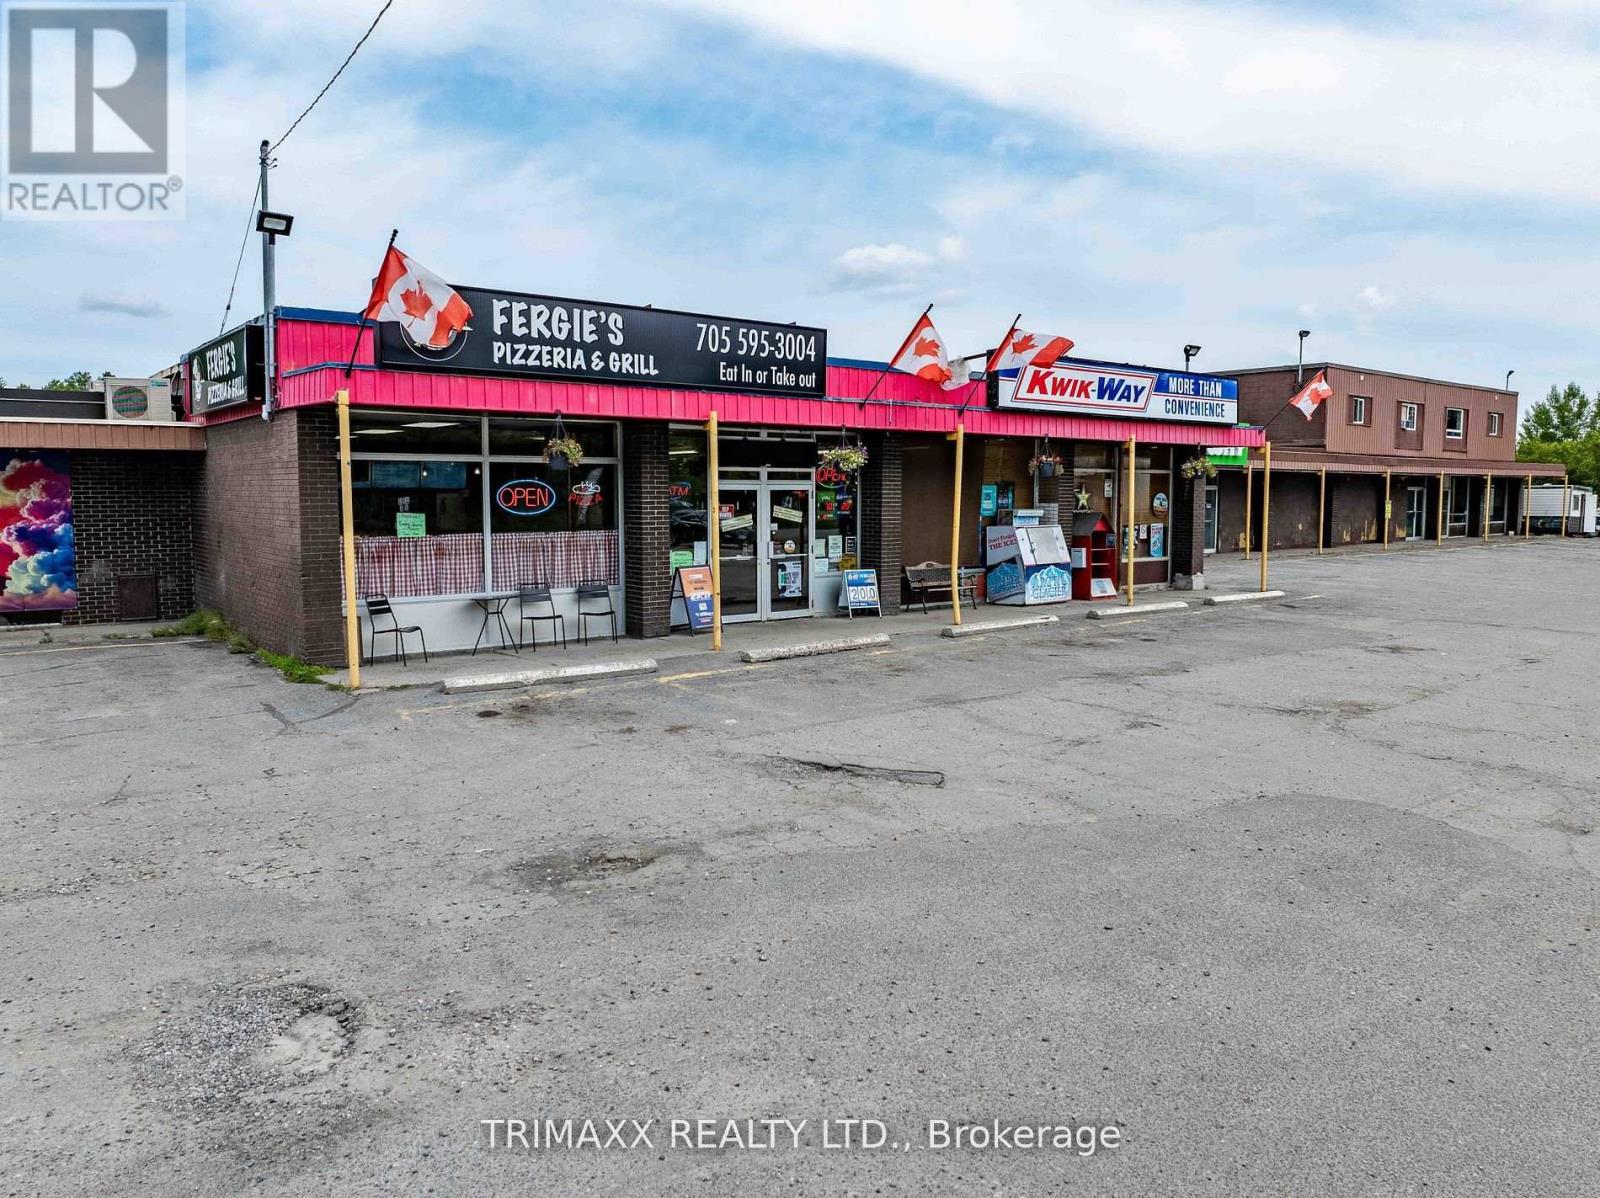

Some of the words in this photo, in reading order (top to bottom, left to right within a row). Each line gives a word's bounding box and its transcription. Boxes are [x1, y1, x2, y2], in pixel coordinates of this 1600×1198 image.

[491, 298, 625, 346] FERGIE'S
[696, 323, 732, 354] 705
[737, 327, 816, 362] 595-3004
[206, 340, 236, 381] FERGIE'S
[492, 341, 587, 370] PIZZERIA
[590, 351, 605, 370] &
[608, 351, 659, 375] GRILL
[719, 361, 738, 382] Eat
[742, 363, 753, 383] In
[756, 369, 768, 384] or
[770, 366, 796, 387] Take
[799, 371, 816, 387] out
[1168, 376, 1195, 396] MORE
[1199, 379, 1223, 398] THAN
[1164, 398, 1226, 418] CONVENIENCE
[500, 487, 548, 507] OPEN
[568, 493, 604, 506] PIZZA
